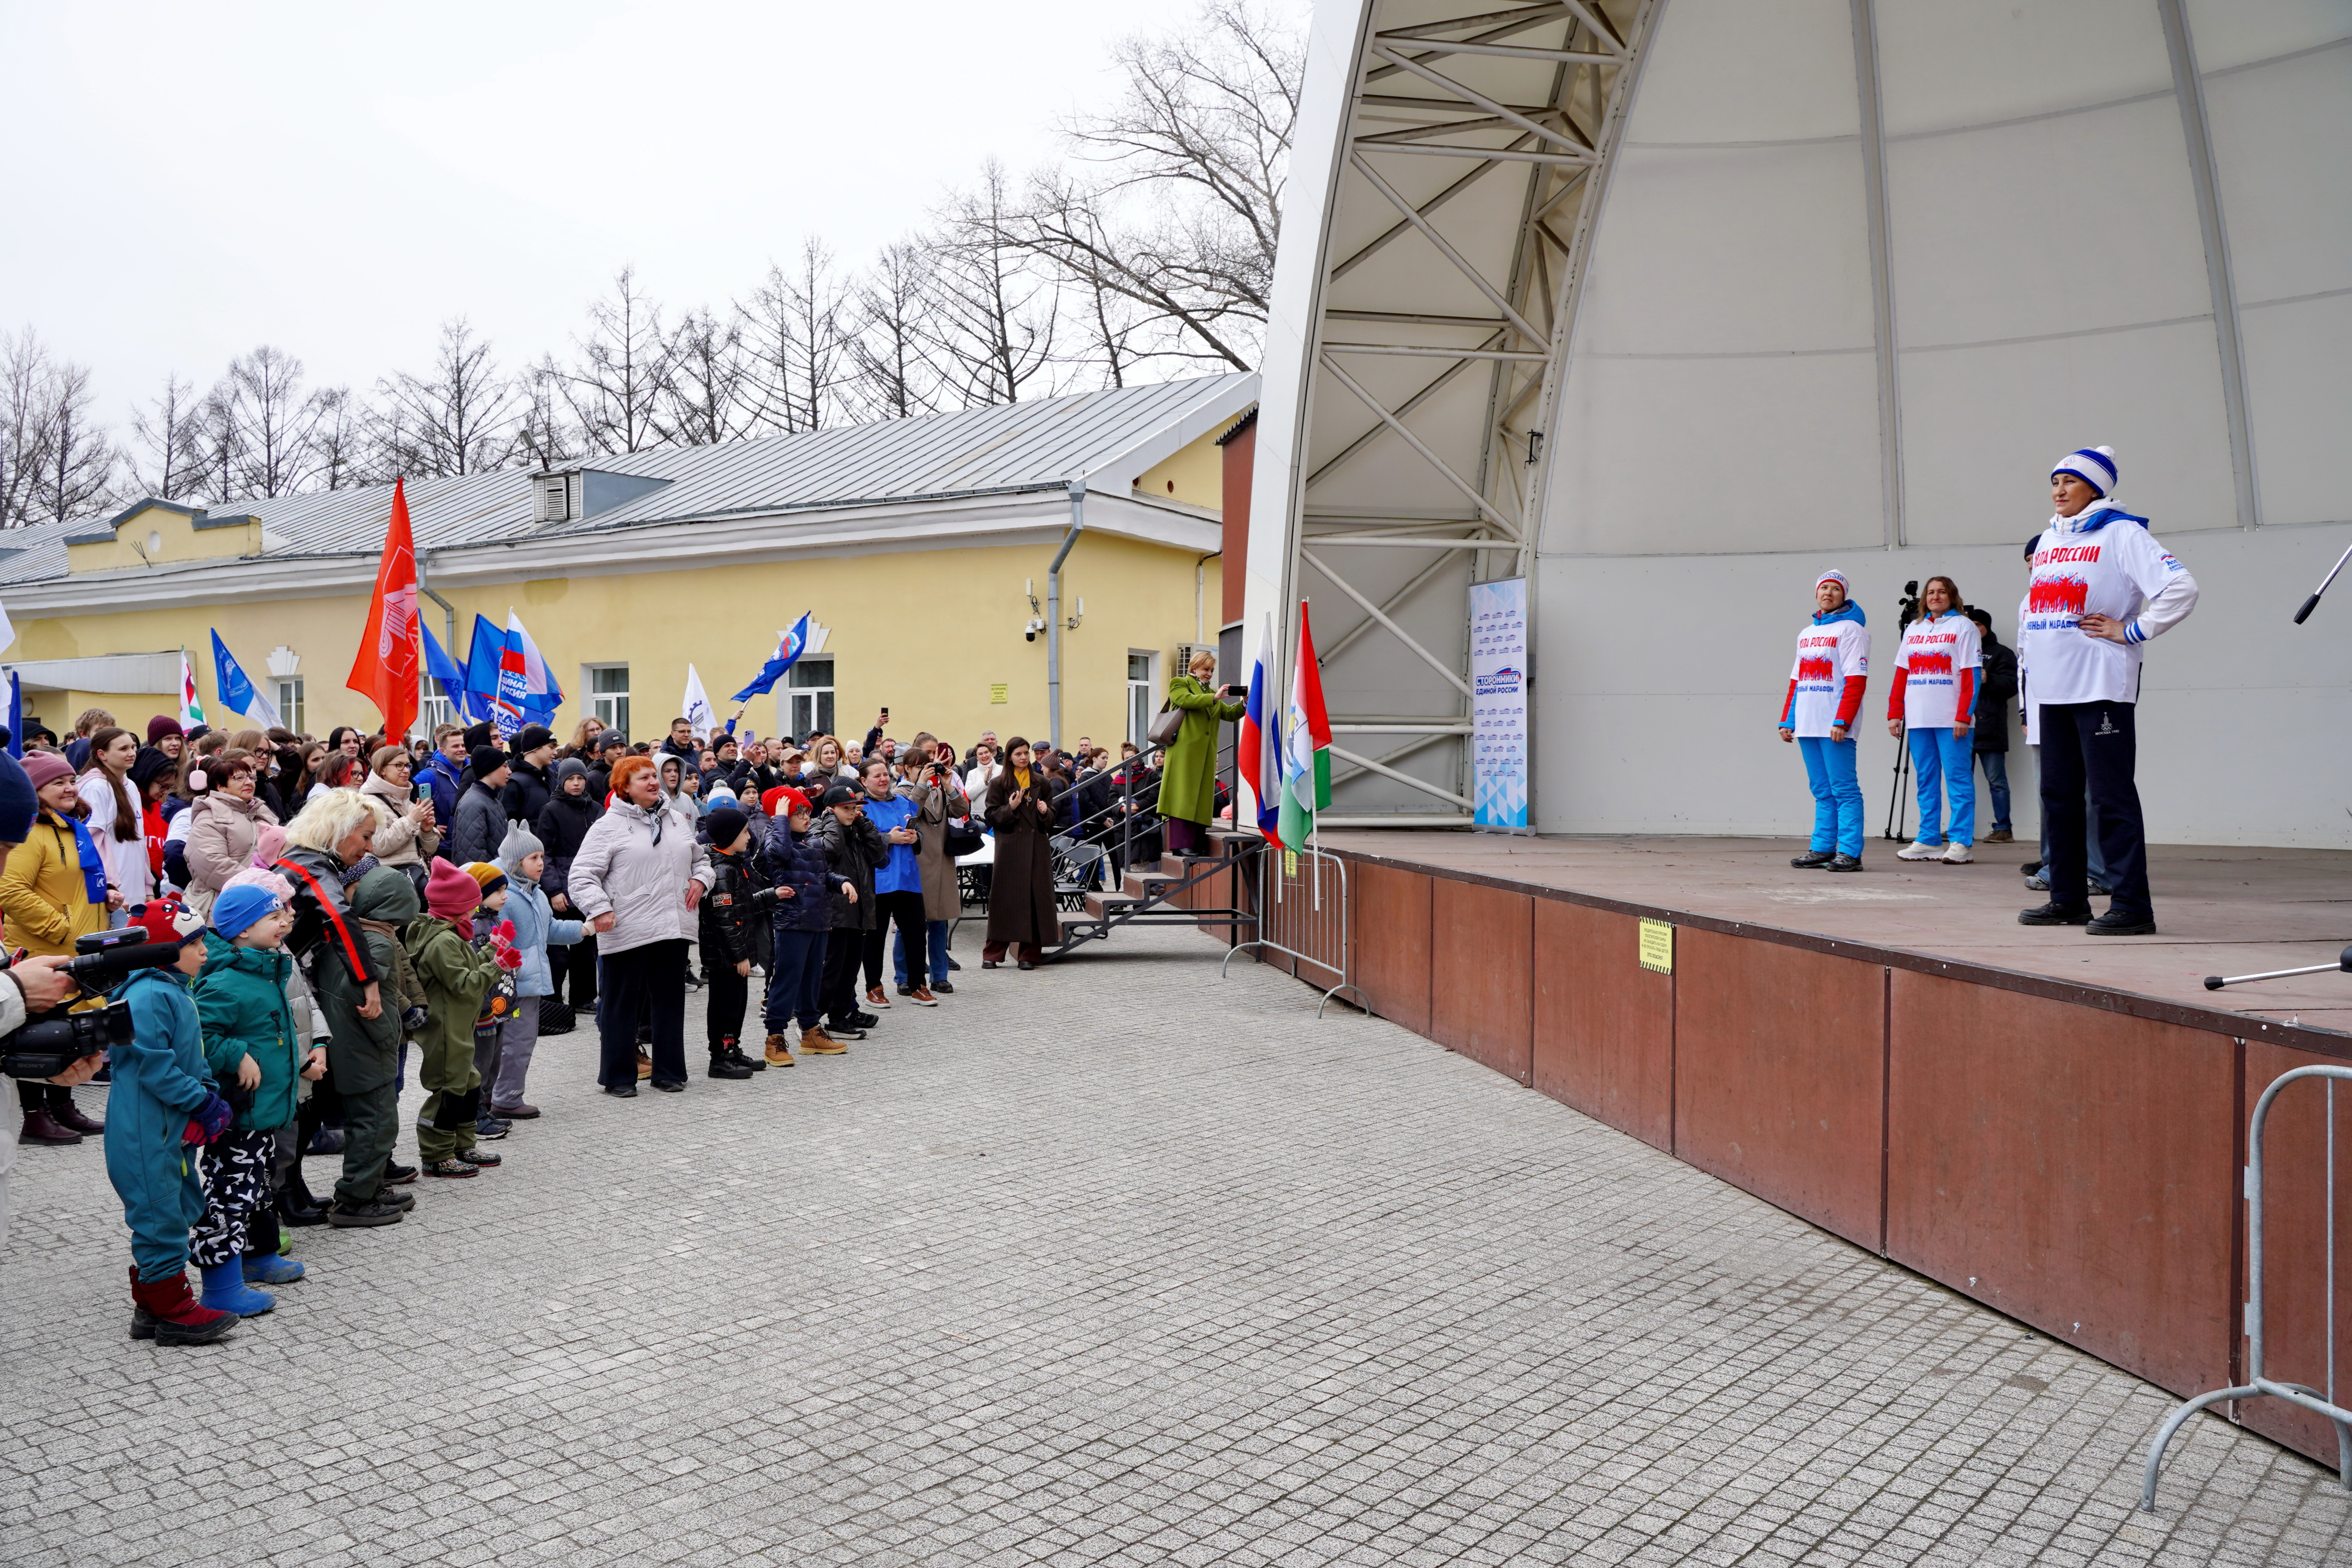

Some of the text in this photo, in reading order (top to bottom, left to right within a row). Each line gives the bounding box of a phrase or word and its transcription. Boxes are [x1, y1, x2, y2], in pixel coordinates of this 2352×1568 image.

[2049, 546, 2101, 564] РОССИИ
[1925, 633, 1957, 644] РОССИИ
[1476, 674, 1518, 686] СТОРОННИКИ
[1476, 686, 1496, 696] ЕДИНОЙ
